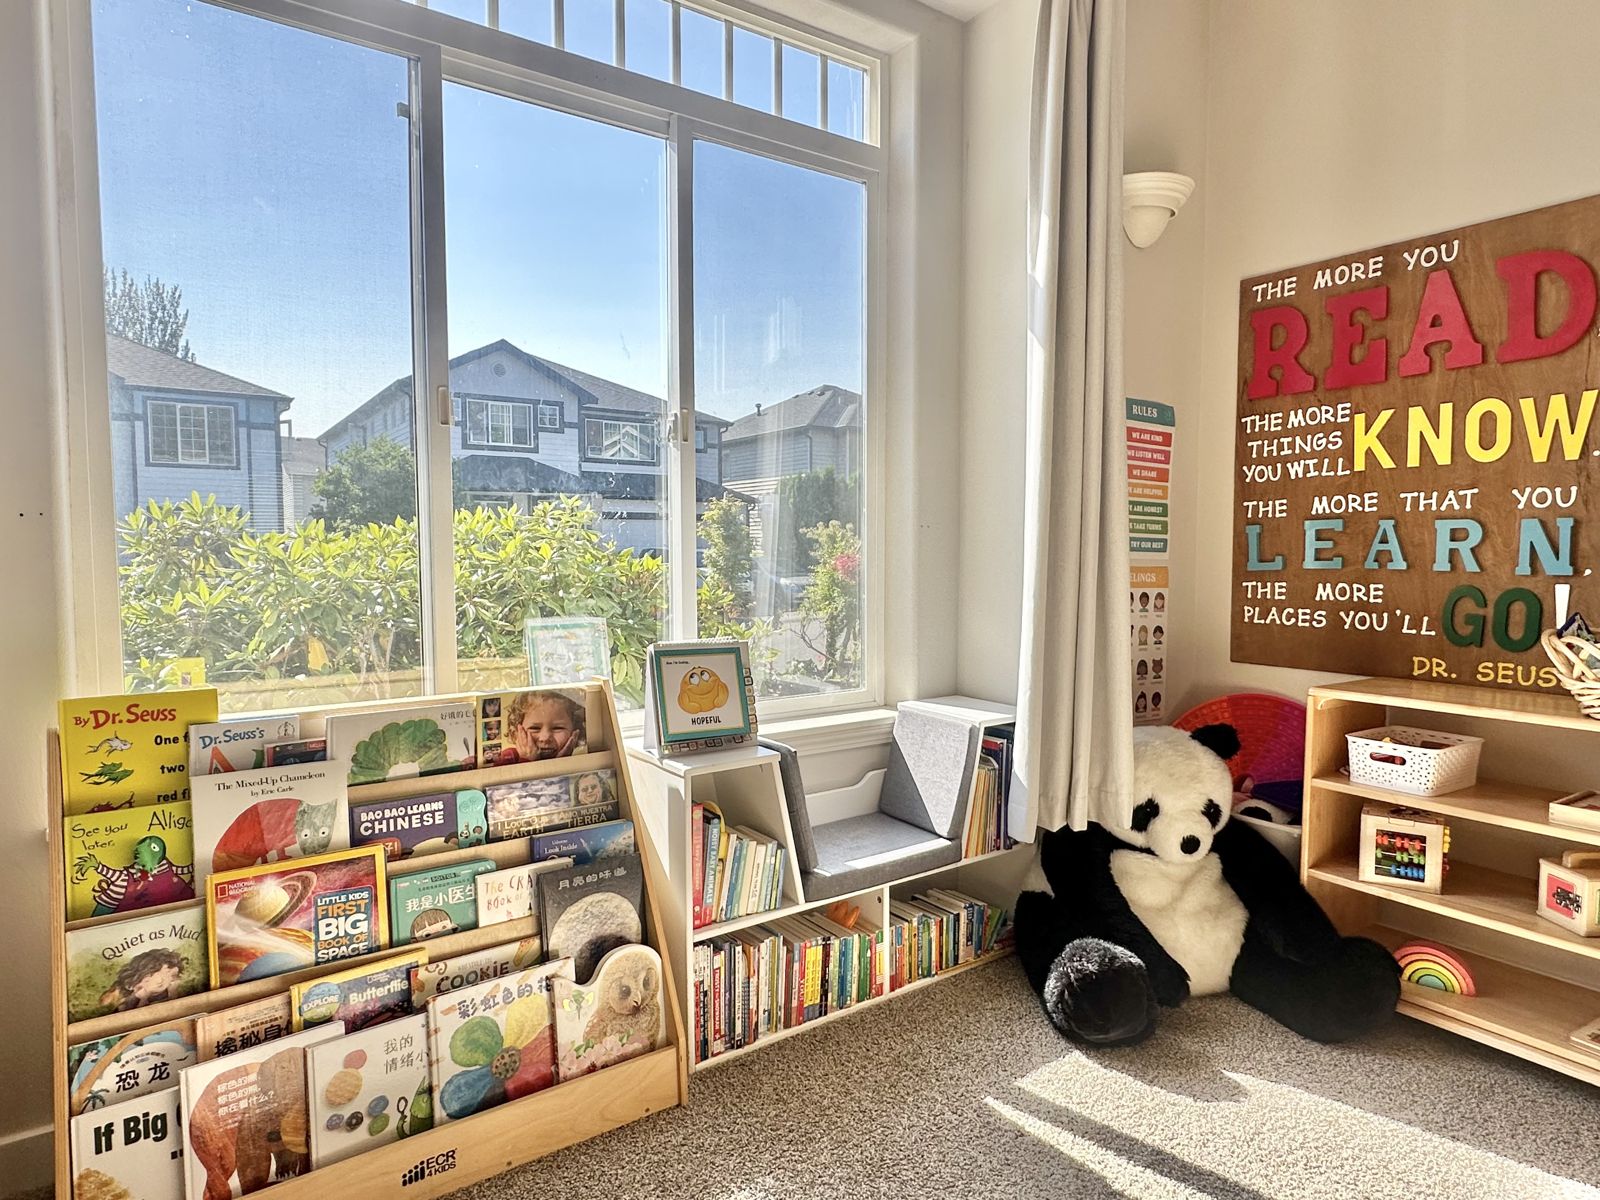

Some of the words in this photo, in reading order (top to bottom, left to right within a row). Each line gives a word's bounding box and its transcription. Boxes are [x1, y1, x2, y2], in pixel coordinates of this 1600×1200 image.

[1251, 276, 1297, 302] THE
[1313, 255, 1384, 289] MORE
[1402, 239, 1460, 271] YOU
[1132, 404, 1158, 418] RULES
[1241, 414, 1283, 434] THE
[1286, 402, 1352, 429] MORE
[1131, 431, 1140, 439] WE
[1141, 432, 1150, 441] ARE
[1151, 434, 1163, 443] KIND
[1247, 430, 1343, 459] THINGS
[1135, 450, 1152, 459] LISTEN
[1153, 452, 1165, 460] WELL
[1132, 468, 1140, 476] WE
[1141, 470, 1157, 478] SHARE
[1242, 463, 1282, 483] YOU
[1286, 457, 1351, 481] WILL
[1133, 487, 1142, 495] ARE
[1243, 498, 1288, 519] THE
[1311, 491, 1379, 516] MORE
[1400, 488, 1479, 512] THAT
[1511, 485, 1578, 510] YOU
[1242, 581, 1287, 601] THE
[1315, 582, 1384, 604] MORE
[1243, 605, 1327, 628] PLACES
[1339, 609, 1436, 637] YOU'LL
[1412, 656, 1457, 679] DR.
[1475, 661, 1560, 688] SEUS
[73, 716, 90, 728] By
[90, 709, 123, 730] Dr.
[126, 703, 176, 724] Seuss
[691, 716, 722, 726] HOPEFUL
[154, 734, 179, 746] One
[199, 734, 222, 749] Dr.
[222, 727, 265, 743] Seuss's
[160, 764, 185, 774] two
[214, 782, 233, 791] The
[236, 776, 278, 788] Mixed-Up
[279, 771, 326, 783] Chameleon
[276, 785, 294, 793] Carle
[157, 789, 177, 802] red
[360, 810, 382, 822] BAO
[384, 807, 405, 818] BAO
[407, 800, 444, 815] LEARNS
[568, 812, 607, 828] TIERRA
[580, 804, 613, 816] NUESTRA
[71, 823, 100, 839] See
[104, 822, 129, 836] you
[360, 810, 445, 836] CHINESE
[502, 824, 544, 840] EARTH
[544, 845, 560, 854] Look
[560, 842, 578, 852] Inside
[710, 828, 718, 850] NOISY
[709, 851, 717, 869] BABY
[558, 866, 627, 891] 月亮的味道
[706, 870, 716, 904] ANIMALS
[318, 894, 347, 906] LITTLE
[348, 891, 369, 901] KIDS
[405, 881, 475, 913] 我是小医生
[317, 900, 369, 919] FIRST
[318, 913, 369, 941] BIG
[101, 933, 145, 960] Quiet
[148, 929, 165, 941] as
[317, 936, 350, 950] BOOK
[353, 933, 368, 943] OF
[317, 942, 369, 962] SPACE
[302, 994, 339, 1011] EXPLORE
[384, 1034, 413, 1055] 我的
[116, 1061, 170, 1093] 恐龙
[93, 1121, 115, 1156] If
[123, 1111, 168, 1147] Big
[426, 1149, 457, 1170] ECR
[427, 1169, 433, 1177] 4
[434, 1160, 457, 1175] KIDS
